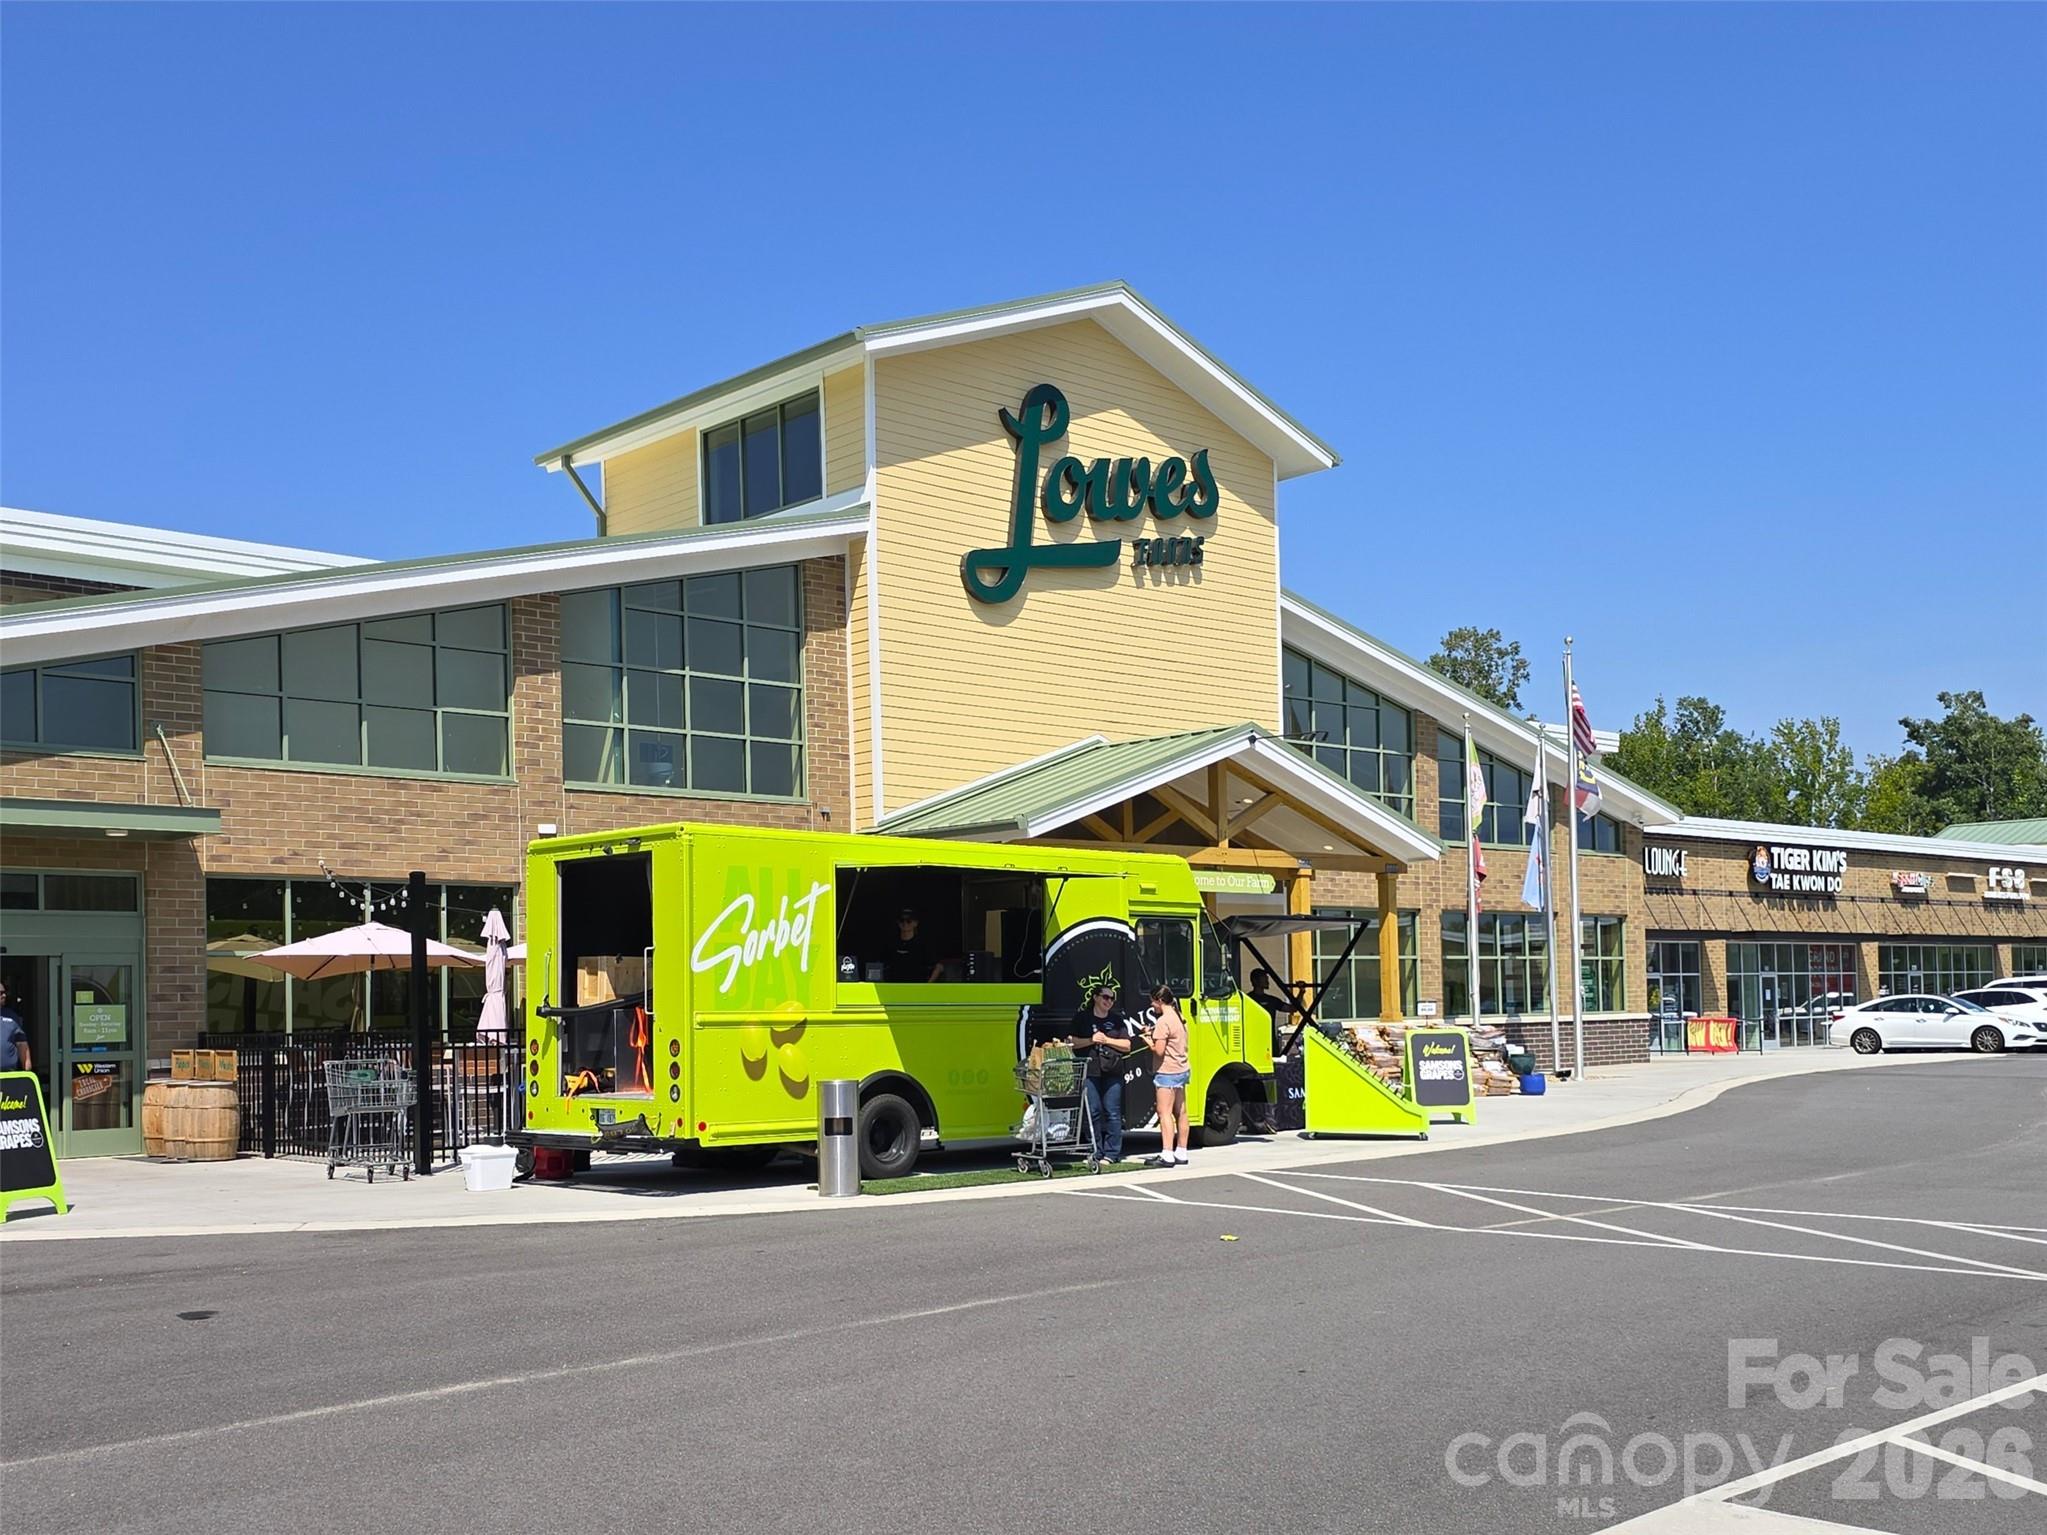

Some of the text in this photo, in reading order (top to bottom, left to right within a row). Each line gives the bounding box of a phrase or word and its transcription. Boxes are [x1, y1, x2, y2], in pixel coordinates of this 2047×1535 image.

[961, 383, 1220, 604] Lowes
[1644, 846, 1688, 877] LOUNGE
[1770, 846, 1848, 873] TIGER KIM'S
[1194, 875, 1270, 889] ome to Our Farm
[1770, 873, 1843, 893] TAE KWON DO
[690, 880, 832, 994] Sorbet
[1418, 1060, 1463, 1072] SAMSONS
[1419, 1070, 1454, 1080] GRAPES
[0, 1092, 28, 1111] elcome!
[0, 1118, 40, 1135] AMSONS
[0, 1133, 33, 1150] RAPES
